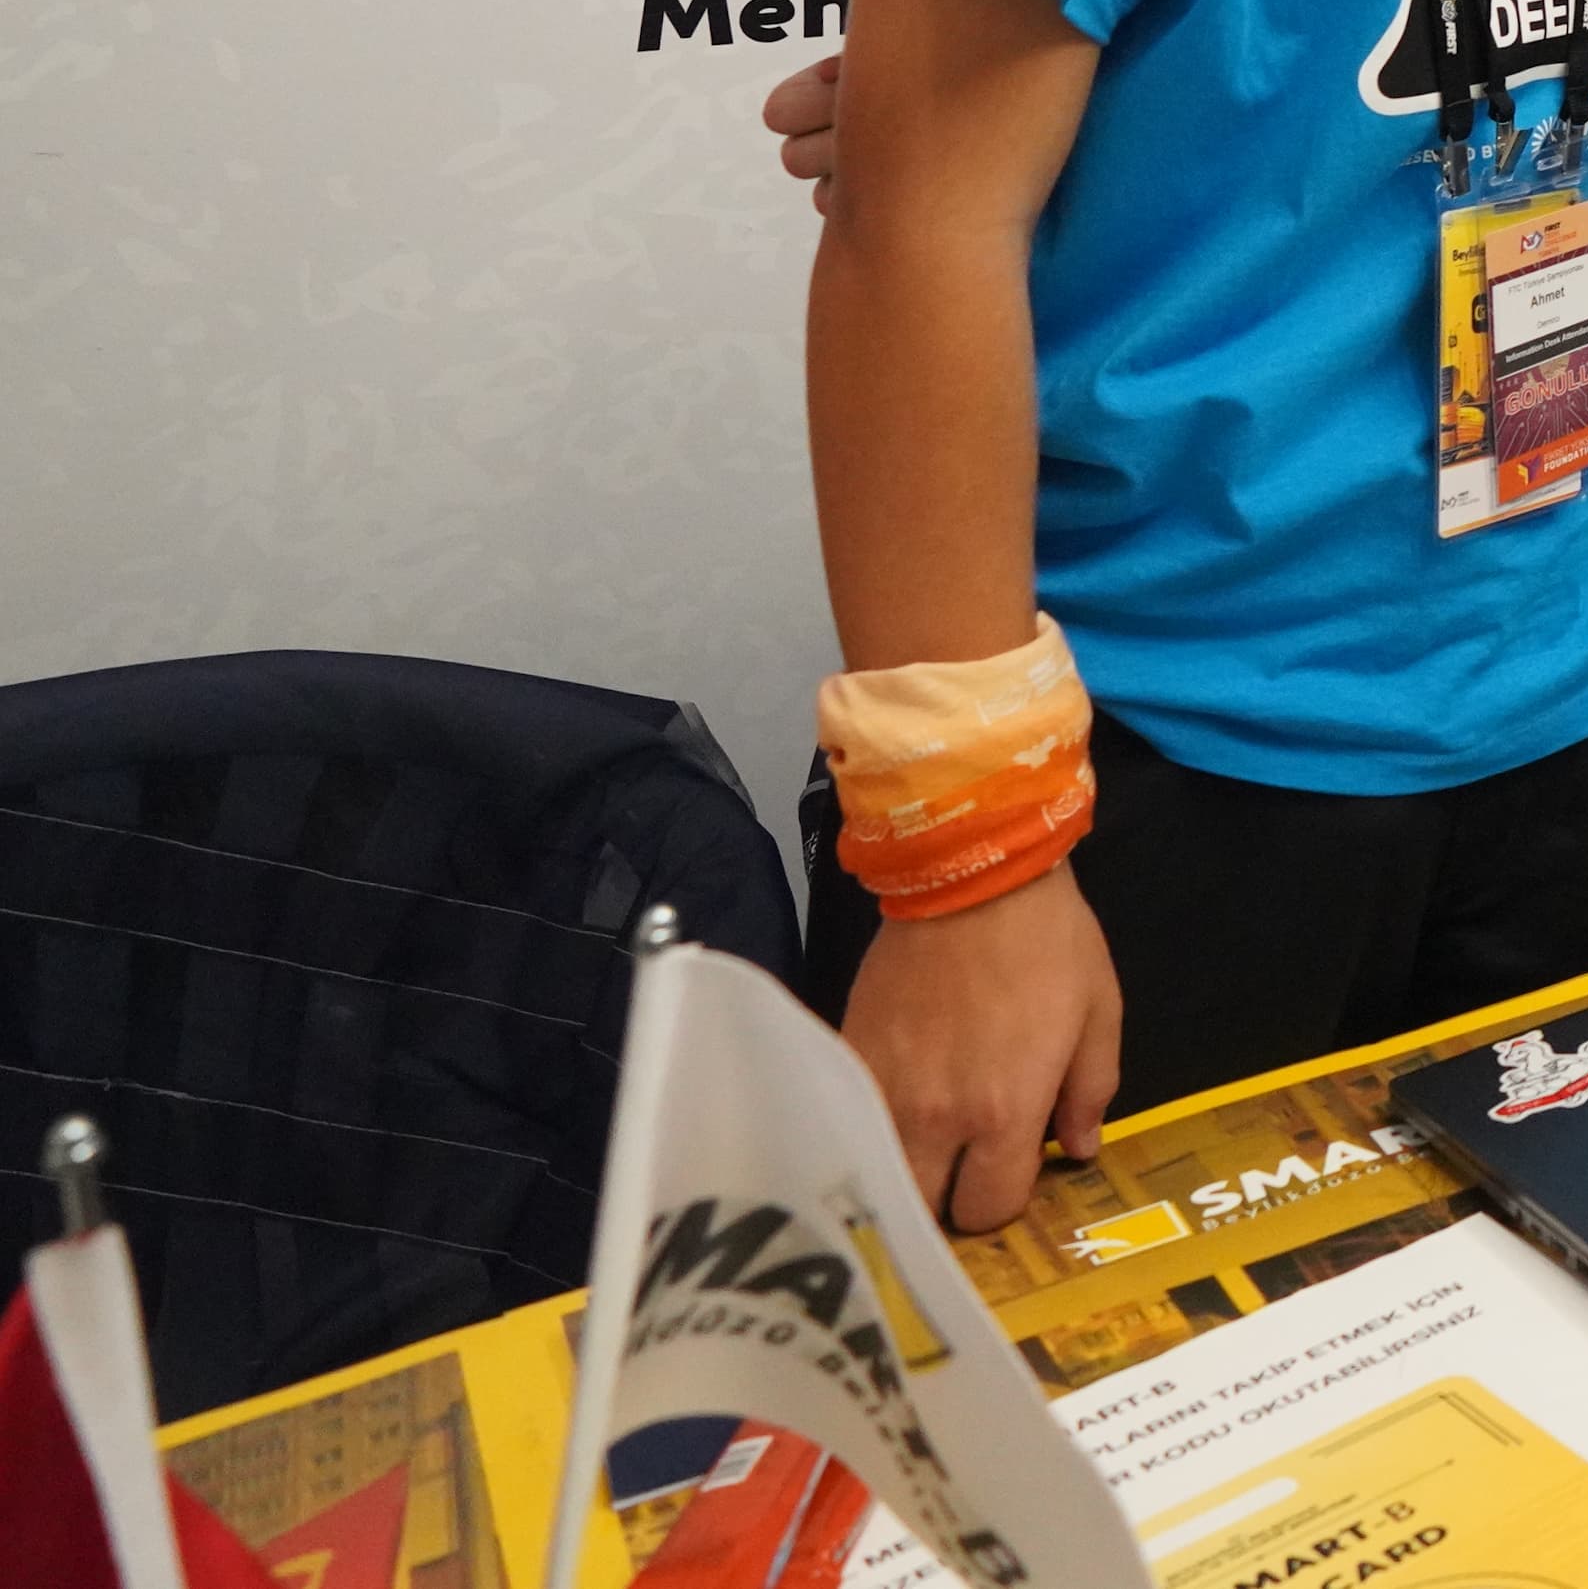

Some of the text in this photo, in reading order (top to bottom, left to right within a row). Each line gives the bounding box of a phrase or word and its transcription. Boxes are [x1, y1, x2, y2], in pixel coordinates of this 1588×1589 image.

[1444, 21, 1458, 55] FIRST
[1530, 287, 1565, 308] Ahmet
[1212, 1281, 1465, 1401] TAKİP ETMEK İÇİN
[1140, 1305, 1482, 1474] KODU OKUTABİLİRSİNİZ
